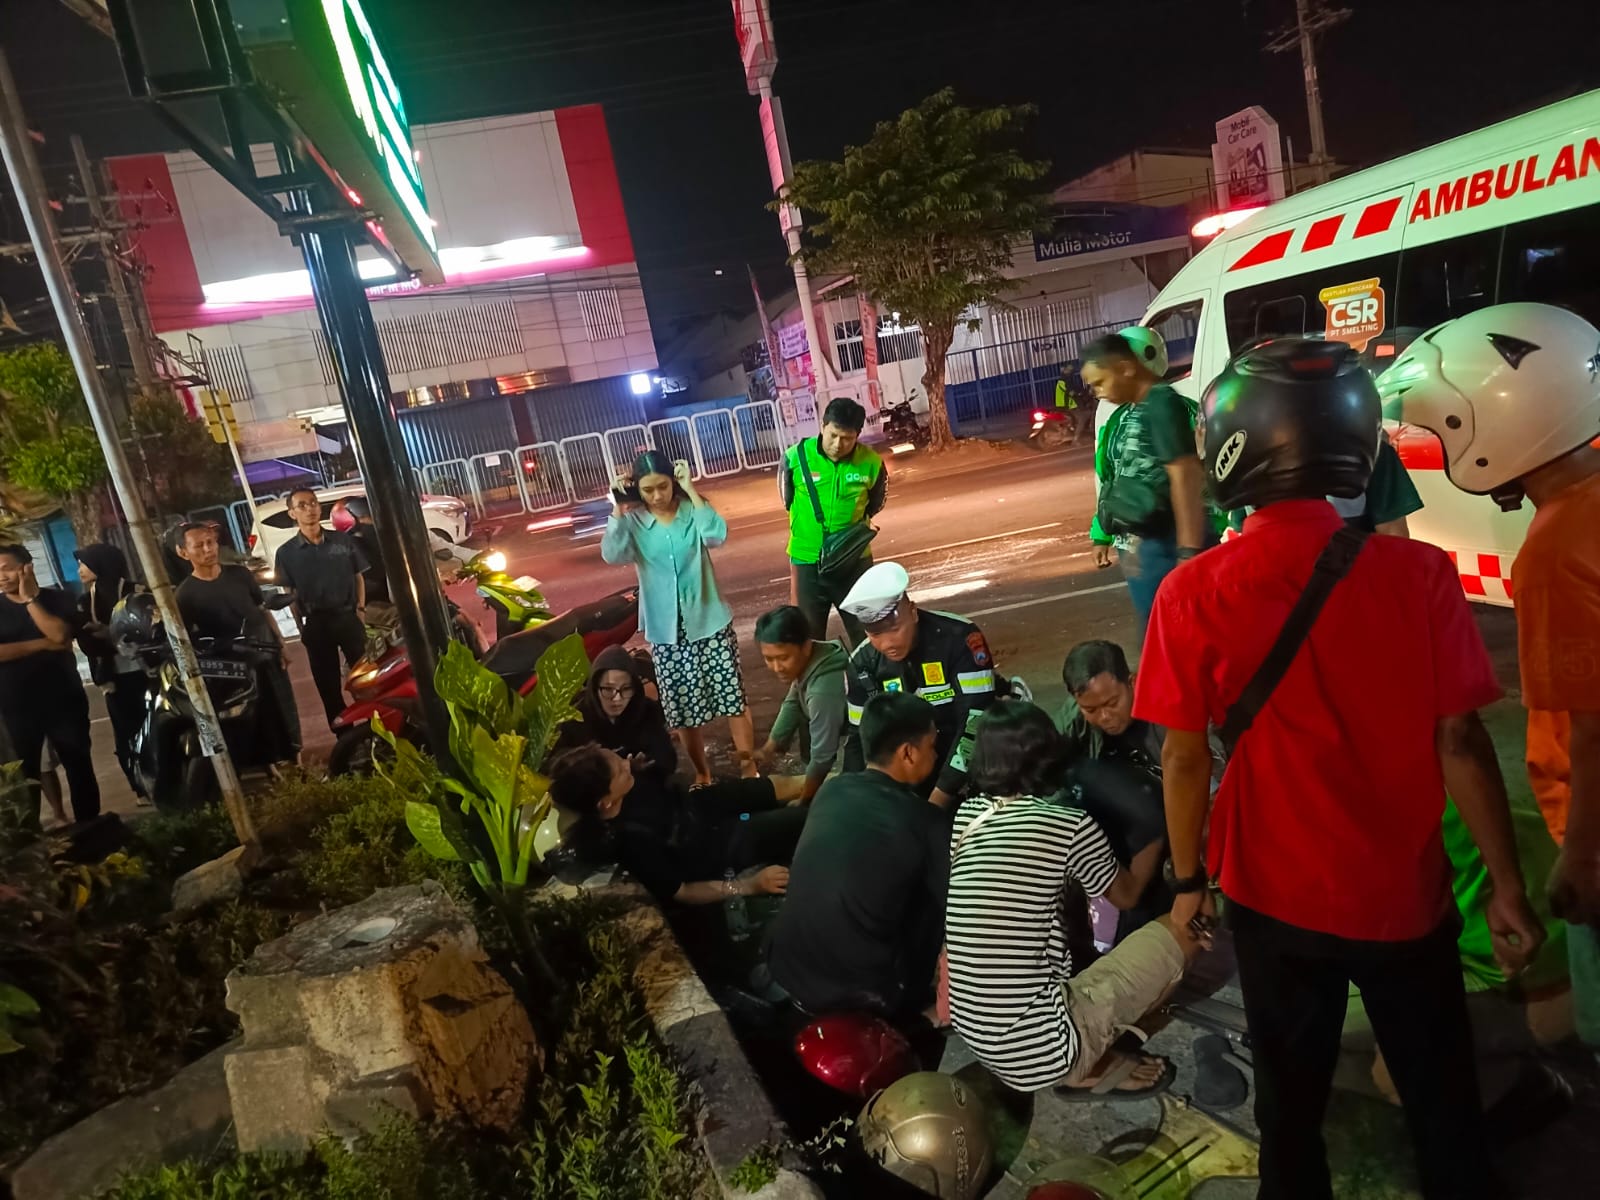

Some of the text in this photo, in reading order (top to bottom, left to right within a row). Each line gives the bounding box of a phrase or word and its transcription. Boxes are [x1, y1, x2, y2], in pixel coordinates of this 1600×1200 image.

[1231, 116, 1250, 132] Mobil
[1228, 126, 1257, 145] Car Care
[1040, 236, 1083, 257] Mulia
[1330, 297, 1379, 328] CSR
[1342, 322, 1379, 336] SMELTING
[1217, 434, 1241, 477] INK
[925, 689, 954, 701] POLRI
